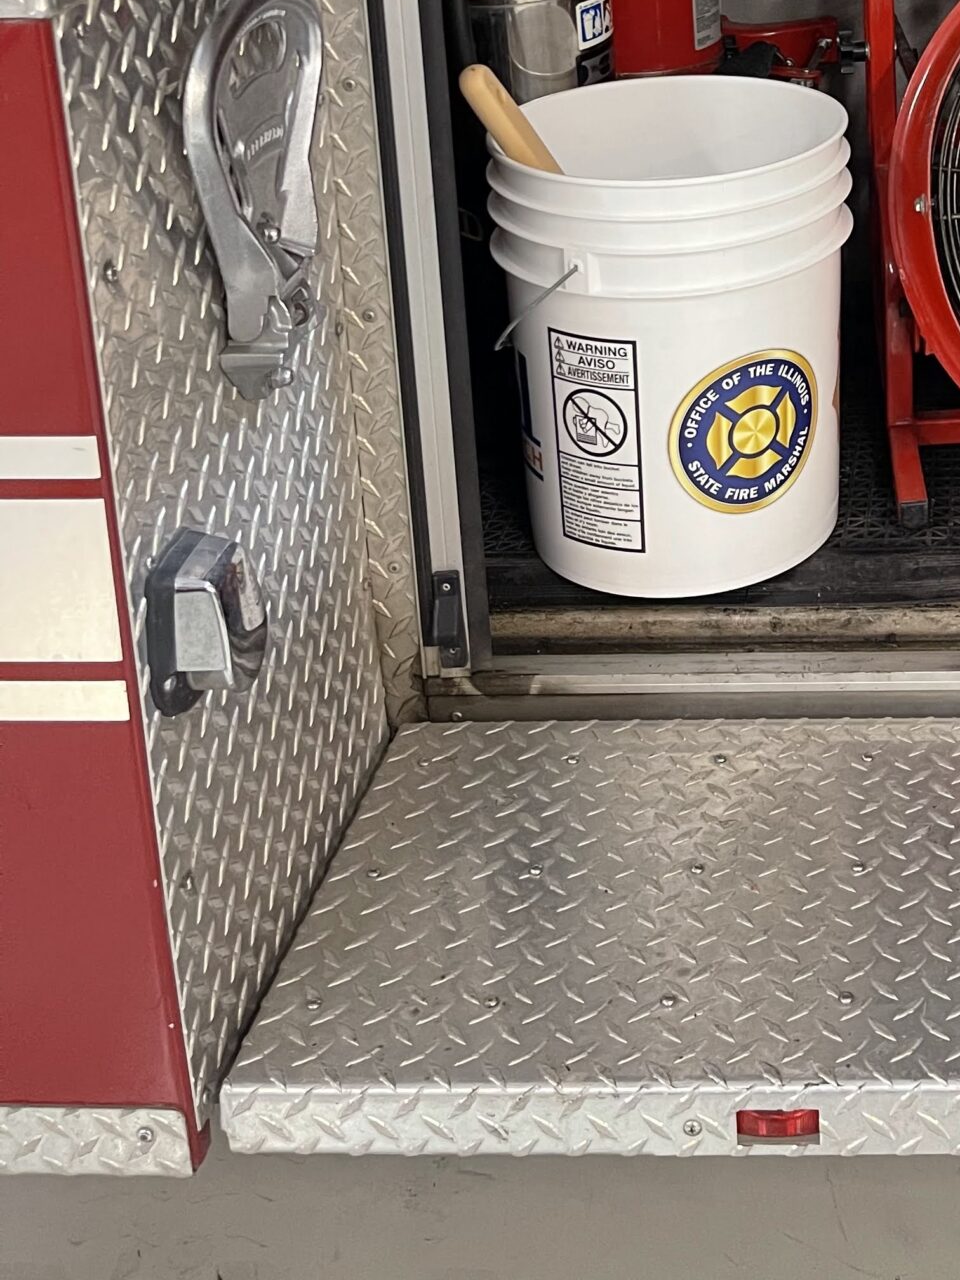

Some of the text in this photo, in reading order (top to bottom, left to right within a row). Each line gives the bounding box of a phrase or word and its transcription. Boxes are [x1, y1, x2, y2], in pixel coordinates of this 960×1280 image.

[566, 339, 628, 358] WARNING
[578, 356, 616, 370] AVISO
[567, 366, 630, 384] AVERTISSEMENT
[684, 363, 810, 439] OFFICE OF THE ILLINOIS
[688, 426, 808, 500] STATE FIRE MARSHAL
